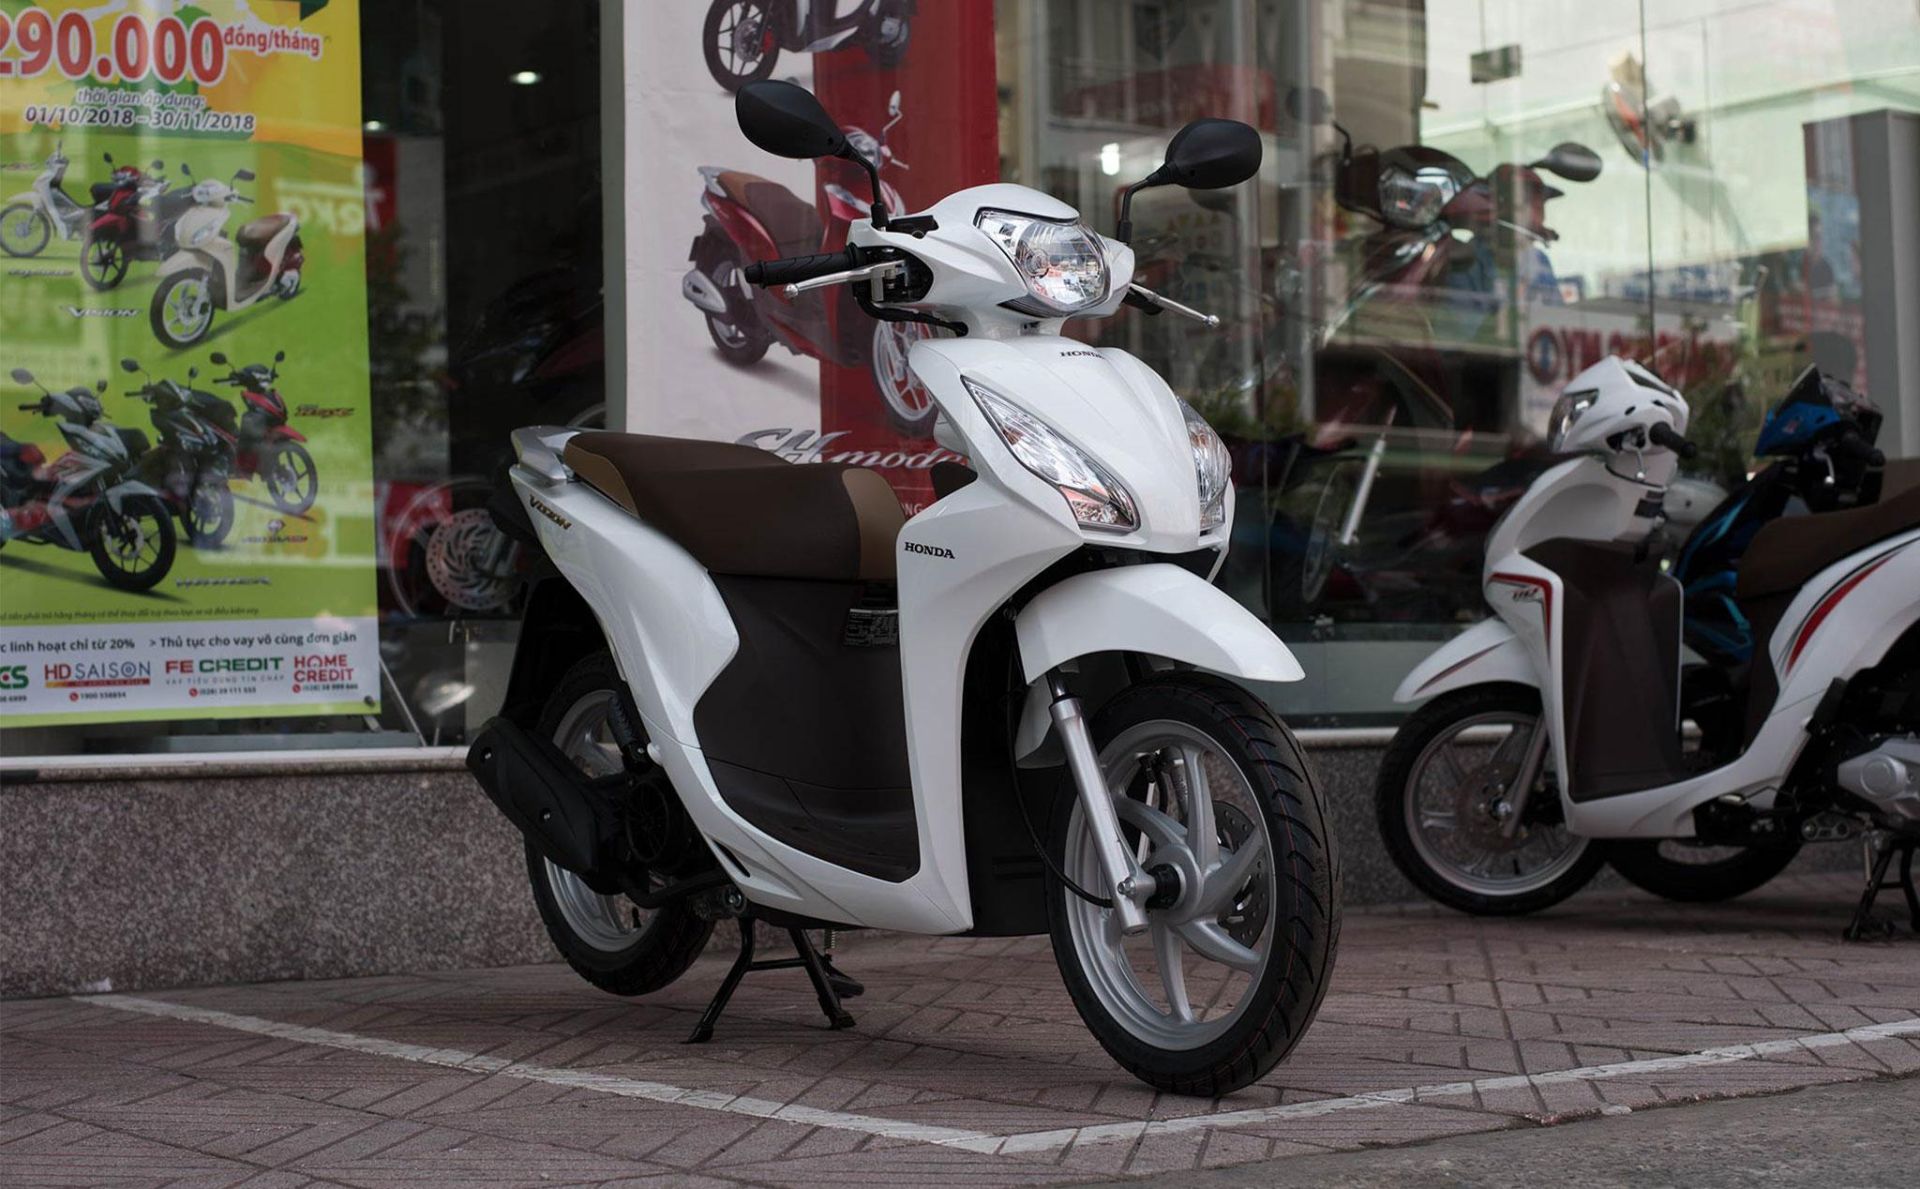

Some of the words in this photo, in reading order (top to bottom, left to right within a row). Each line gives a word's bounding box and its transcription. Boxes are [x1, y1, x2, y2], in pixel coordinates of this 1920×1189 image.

[26, 106, 133, 124] 01/10/2018
[152, 111, 254, 129] 30/11/2018
[904, 542, 956, 560] HONDA
[10, 640, 34, 652] linh
[38, 641, 66, 653] hoạt
[110, 639, 135, 649] 20%
[161, 634, 182, 647] Thủ
[186, 637, 206, 649] tục
[209, 635, 231, 647] cho
[233, 636, 255, 648] vay
[258, 633, 272, 644] vô
[275, 634, 304, 647] cùng
[306, 632, 329, 643] đơn
[332, 631, 357, 645] giản
[165, 660, 194, 674] FE
[199, 657, 284, 673] CREDIT
[293, 654, 348, 669] HOME
[44, 663, 72, 680] HD
[75, 661, 151, 680] SAISON
[293, 668, 355, 683] CREDIT
